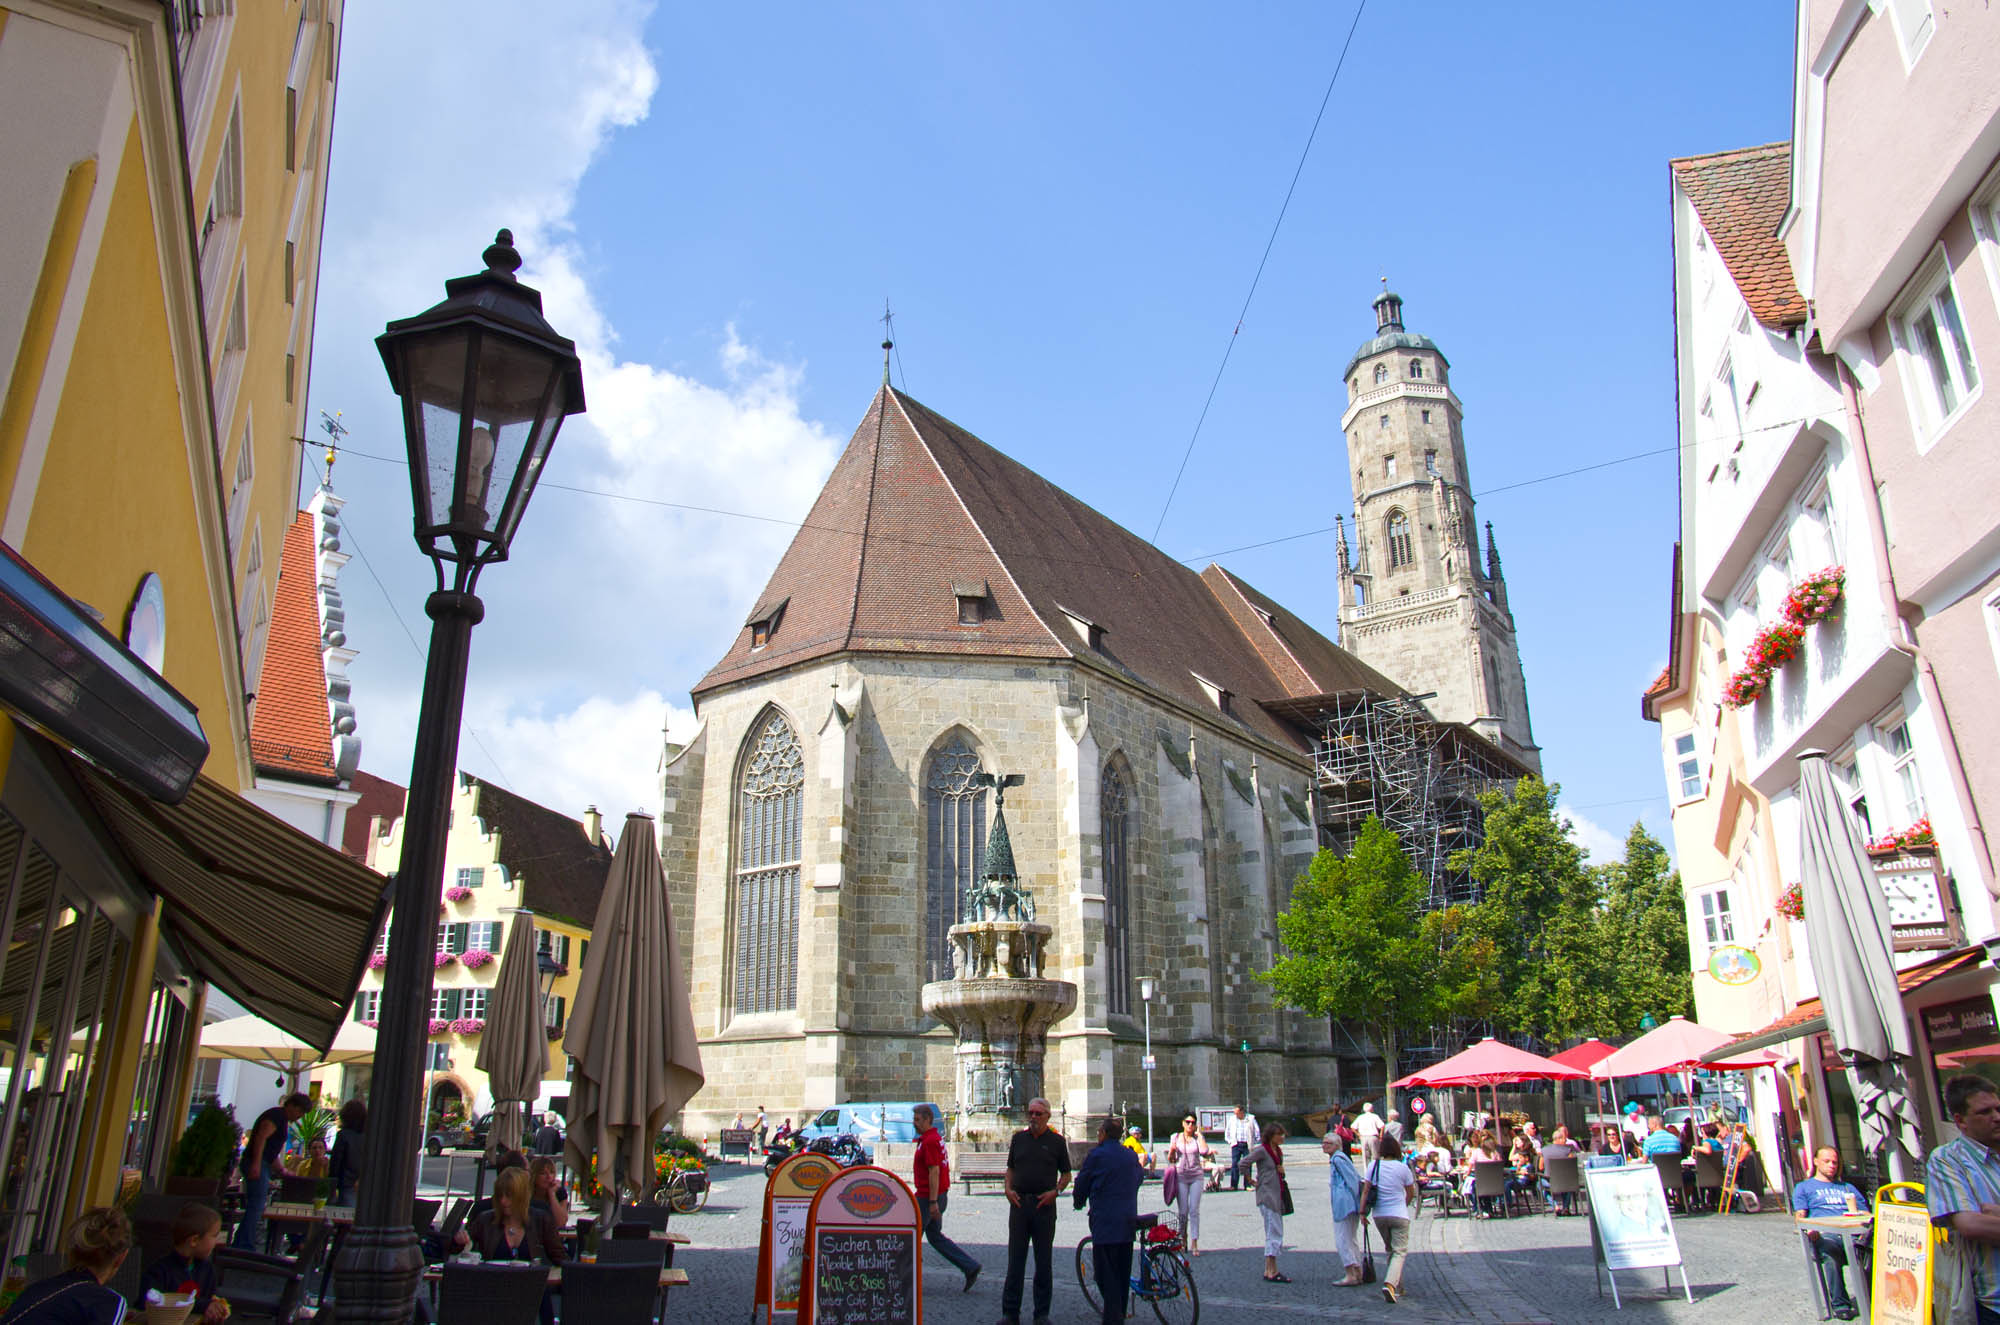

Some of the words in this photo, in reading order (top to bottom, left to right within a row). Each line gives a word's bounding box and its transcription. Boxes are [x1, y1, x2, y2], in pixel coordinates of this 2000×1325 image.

[1893, 928, 1945, 938] chlientz
[853, 1192, 881, 1204] MACK
[776, 1220, 806, 1244] Zwe
[788, 1240, 806, 1258] da
[823, 1235, 872, 1253] Suchen
[1887, 1250, 1918, 1271] Sonne
[860, 1273, 886, 1291] Basis
